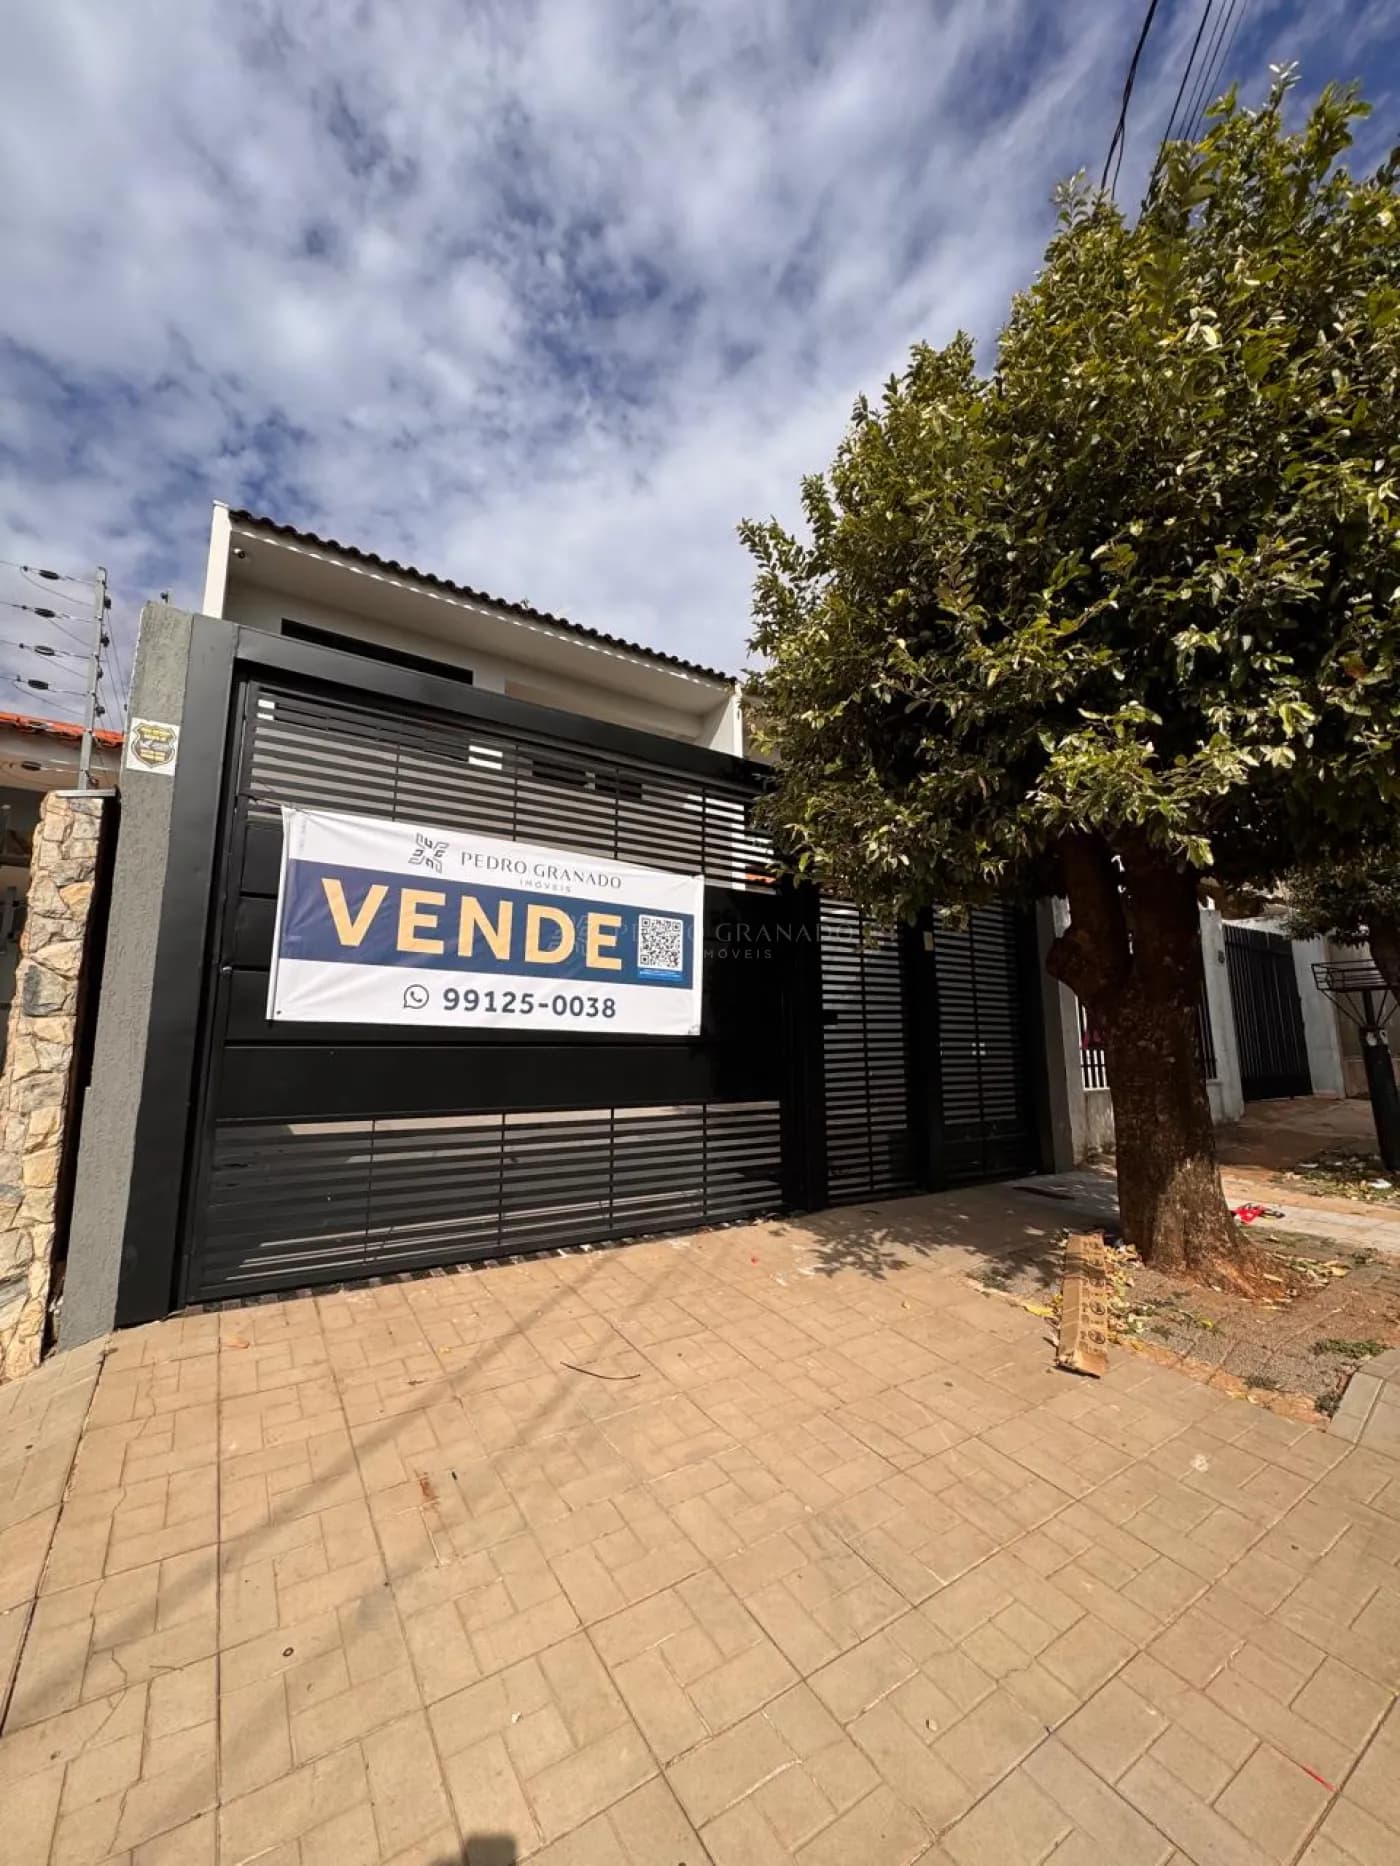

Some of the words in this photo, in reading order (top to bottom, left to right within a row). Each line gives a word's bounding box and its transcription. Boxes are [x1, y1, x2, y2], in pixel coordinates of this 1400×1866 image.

[461, 851, 527, 875] PEDRO
[533, 863, 622, 889] GRANADO
[321, 878, 622, 970] VENDE
[443, 988, 616, 1018] 99125-0038
